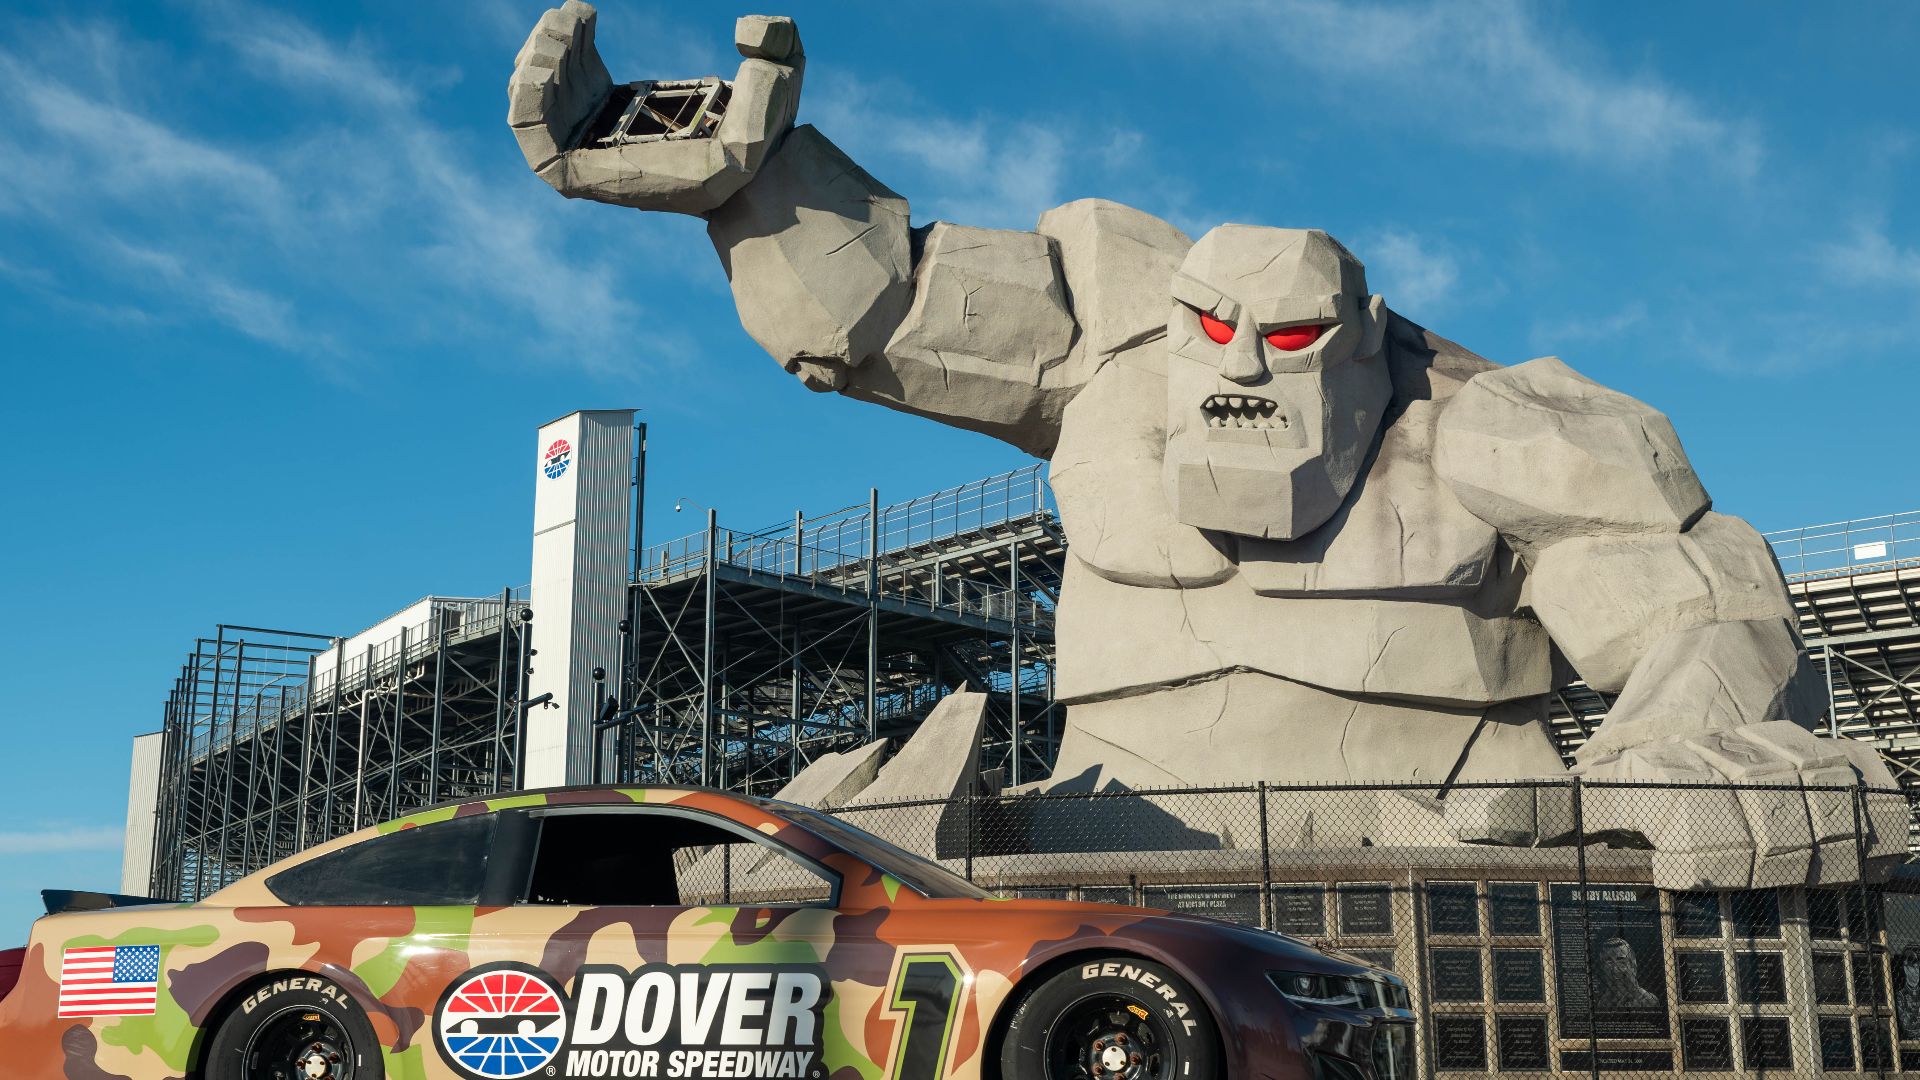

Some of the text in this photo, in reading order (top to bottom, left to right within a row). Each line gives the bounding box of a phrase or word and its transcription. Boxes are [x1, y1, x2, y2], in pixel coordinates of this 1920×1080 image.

[1602, 890, 1637, 901] ALLISON
[241, 977, 348, 1014] GENERAL
[571, 971, 821, 1046] DOVER
[879, 944, 974, 1080] 1
[1083, 962, 1197, 1037] GENERAL
[565, 1050, 815, 1078] MOTOR SPEEDWAY
